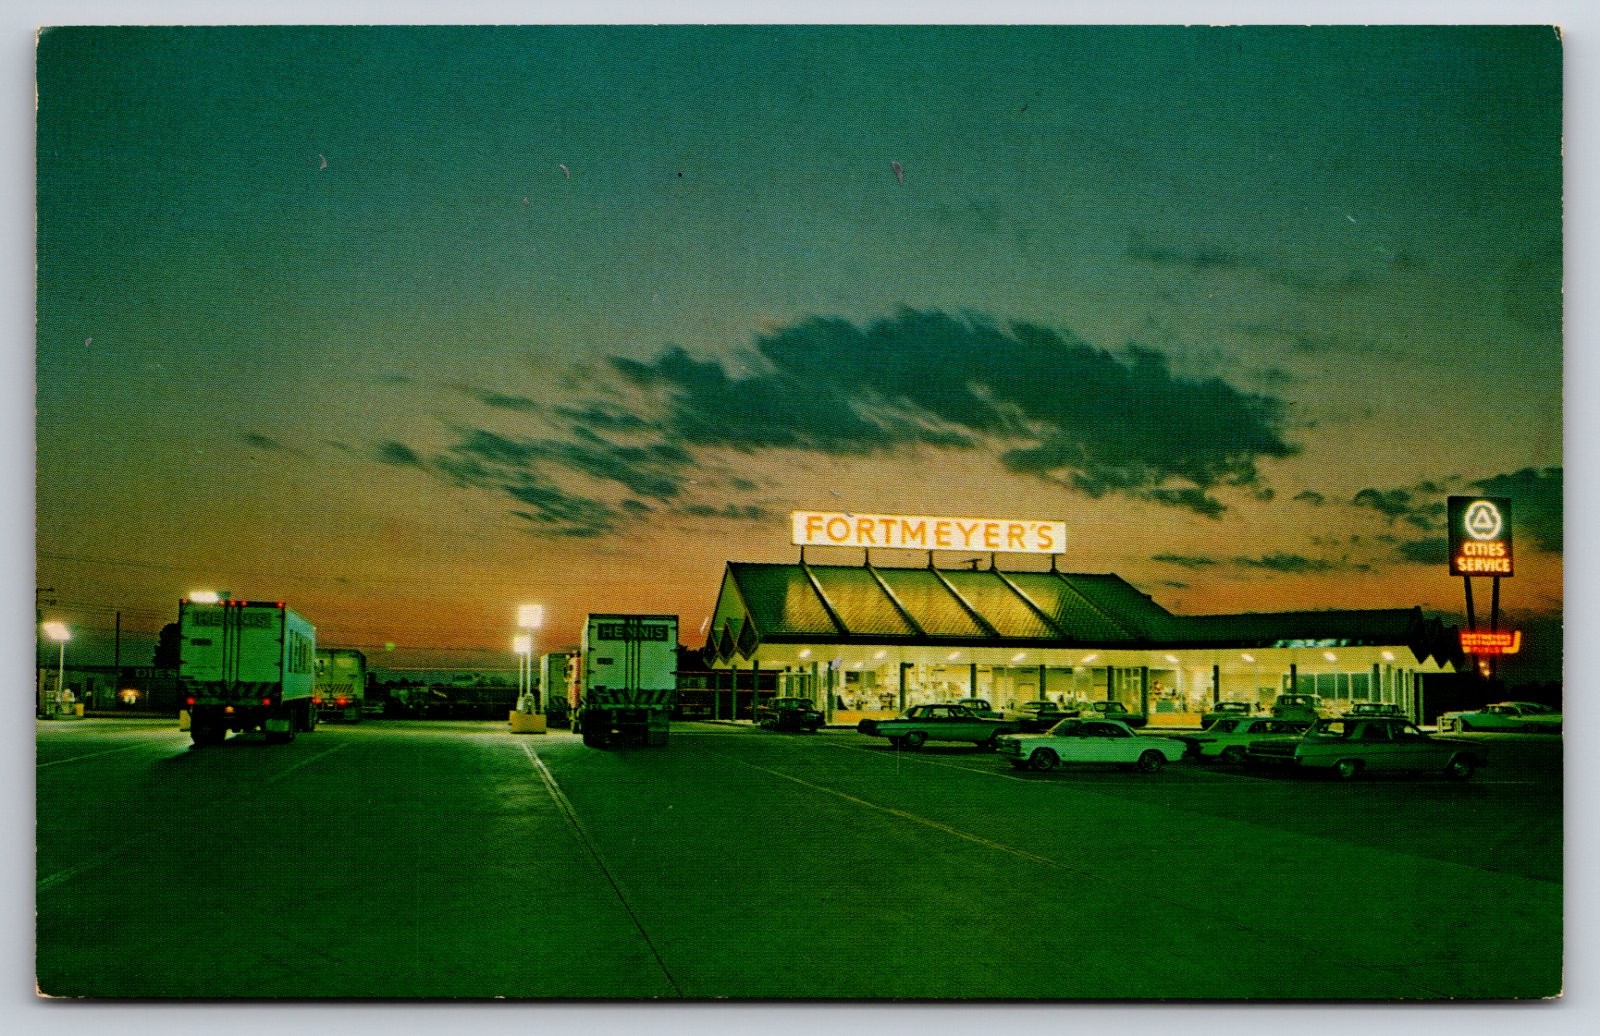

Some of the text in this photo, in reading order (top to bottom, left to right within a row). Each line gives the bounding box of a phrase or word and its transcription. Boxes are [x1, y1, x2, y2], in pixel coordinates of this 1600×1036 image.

[805, 515, 1055, 551] FORTMEYER'S
[1463, 541, 1506, 557] CITIES
[1457, 556, 1511, 572] SERVICE
[602, 626, 664, 638] HENNIS
